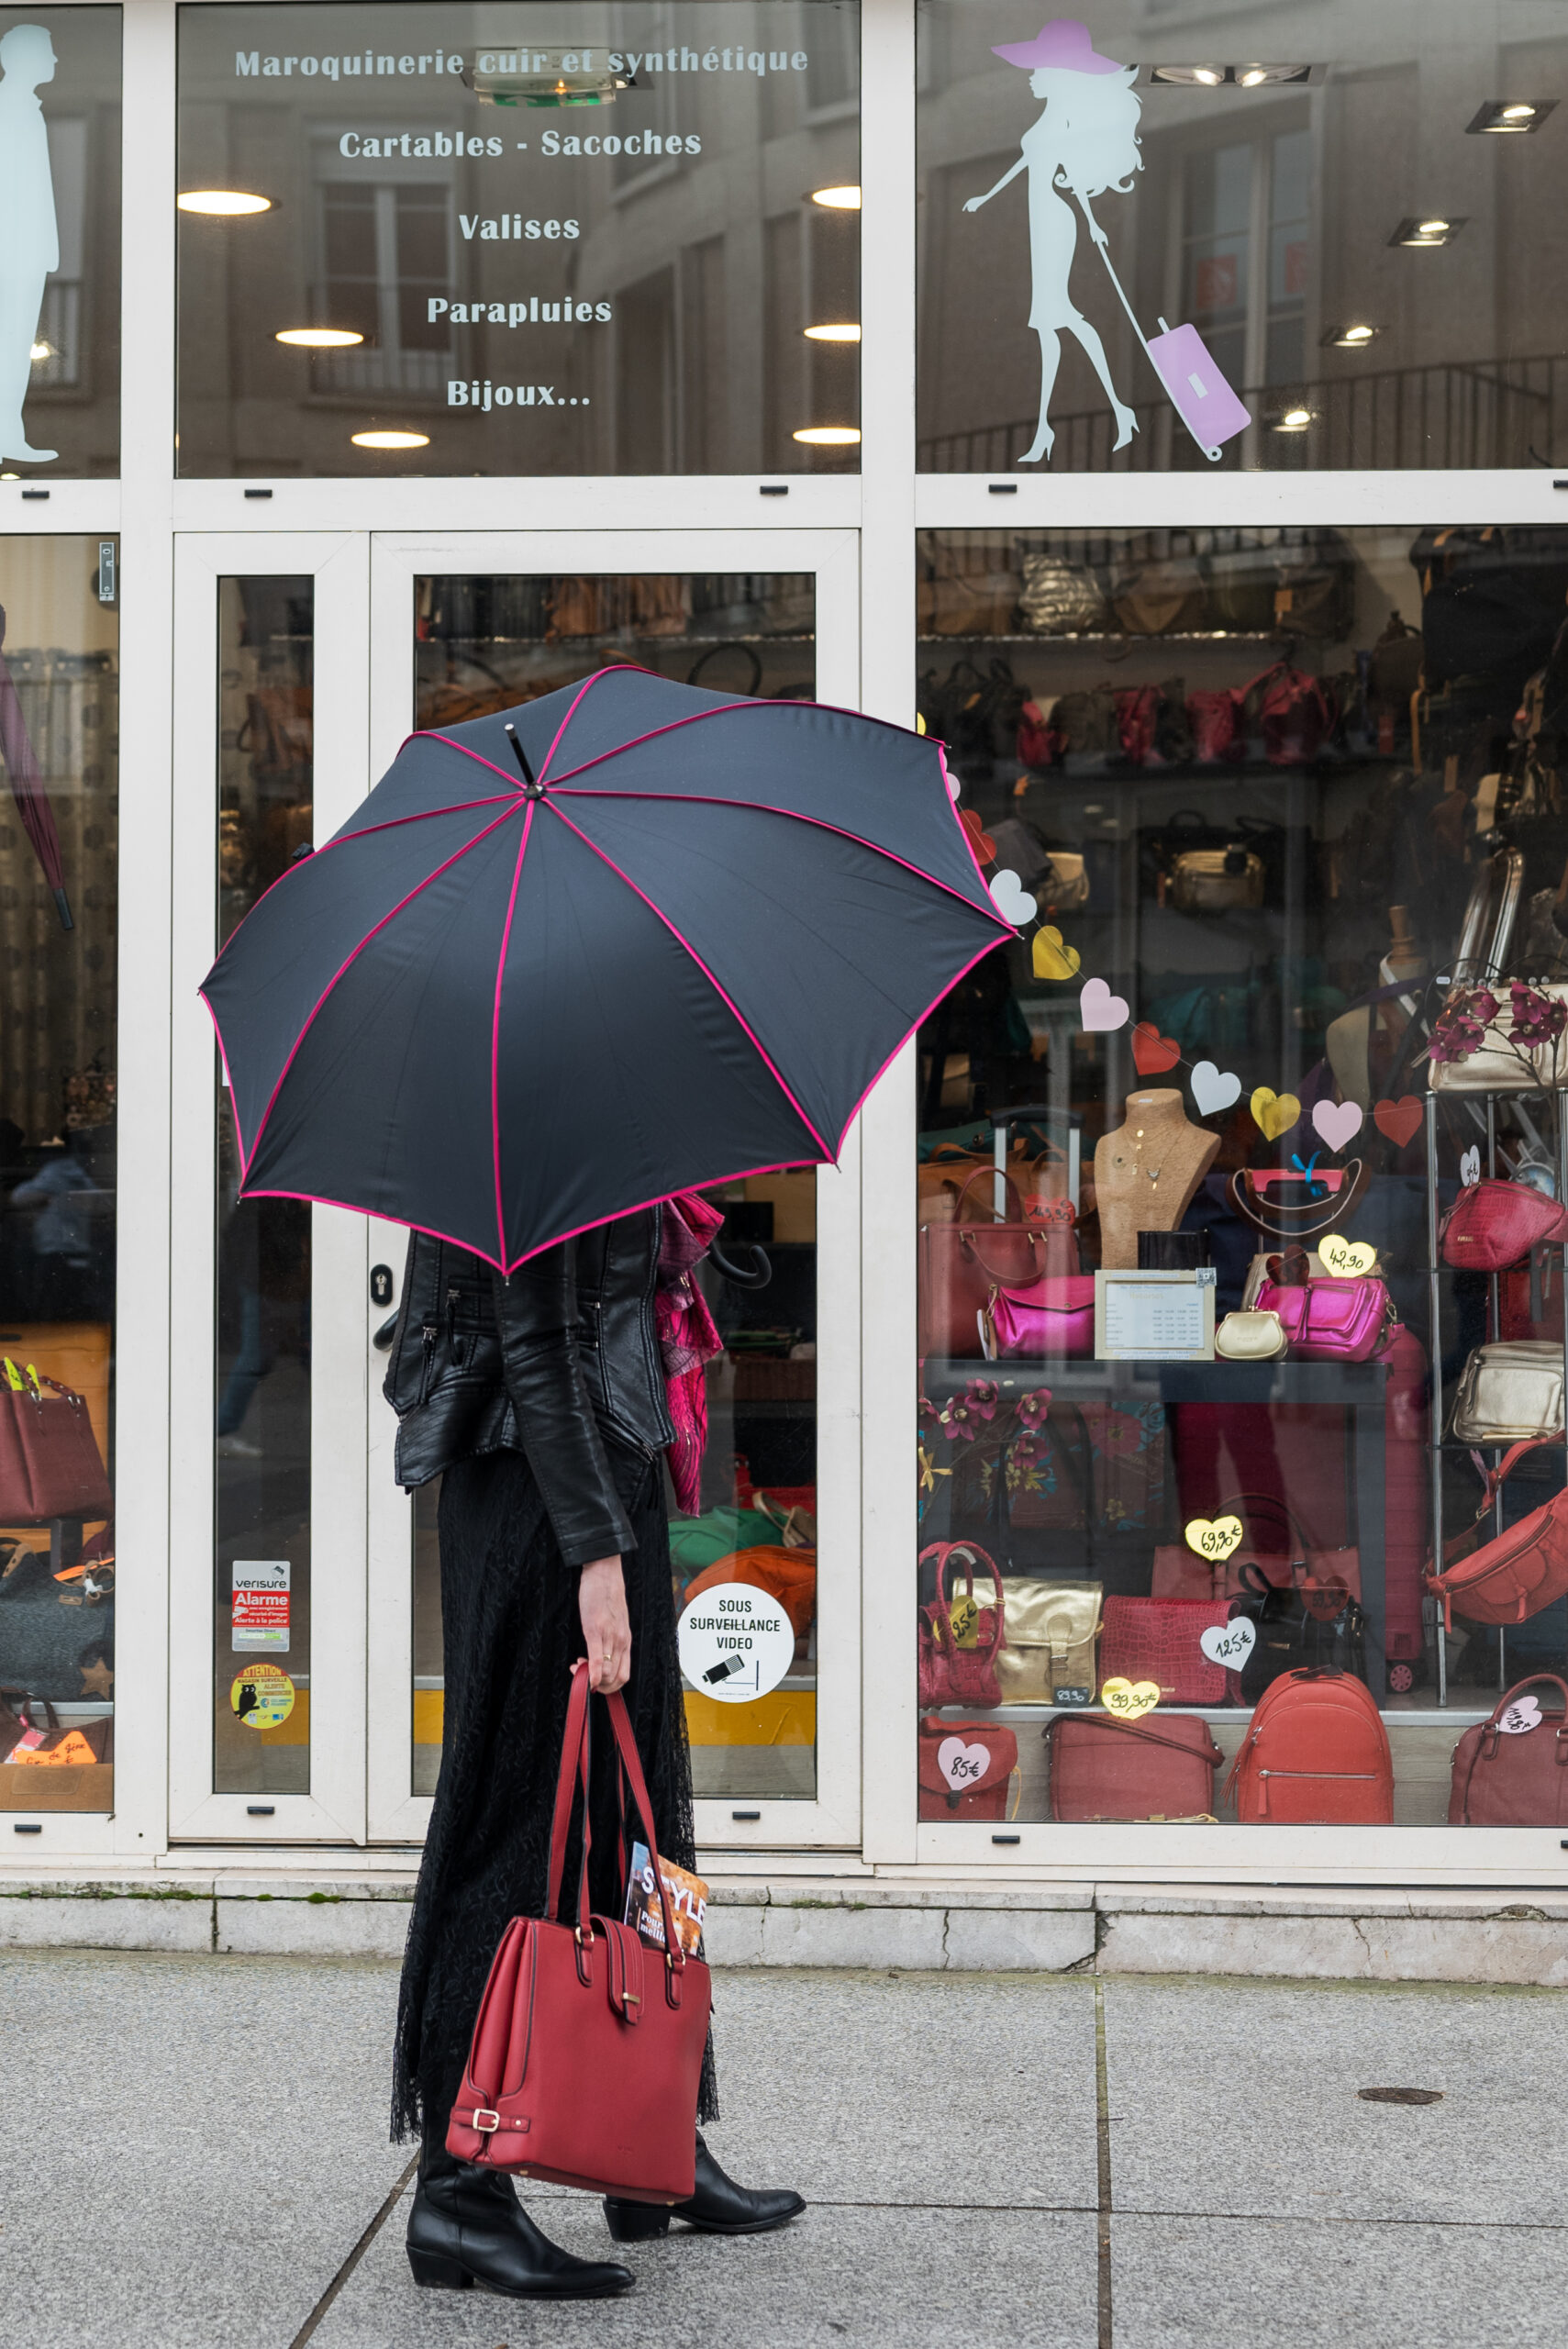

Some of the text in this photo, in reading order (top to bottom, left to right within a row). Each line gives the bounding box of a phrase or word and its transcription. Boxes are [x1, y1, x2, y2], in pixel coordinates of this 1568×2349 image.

[234, 45, 808, 81] Maroquinerie cuir et synthétique
[339, 131, 504, 159] Cartables
[540, 129, 702, 156] Sacoches
[459, 214, 580, 239] Valises
[428, 296, 612, 328] Parapluies
[447, 380, 591, 412] Bijoux...
[1329, 1248, 1363, 1270] 42,90
[1201, 1524, 1241, 1553] 69,90€
[236, 1580, 286, 1588] verisure
[235, 1592, 287, 1605] Alarme
[718, 1599, 751, 1612] SOUS
[690, 1618, 780, 1631] SURVEILLANCE
[717, 1637, 752, 1649] VIDEO
[1216, 1631, 1251, 1658] 125€
[243, 1664, 282, 1676] ATTENTION
[951, 1756, 979, 1777] 85€
[641, 1909, 664, 1929] Pour
